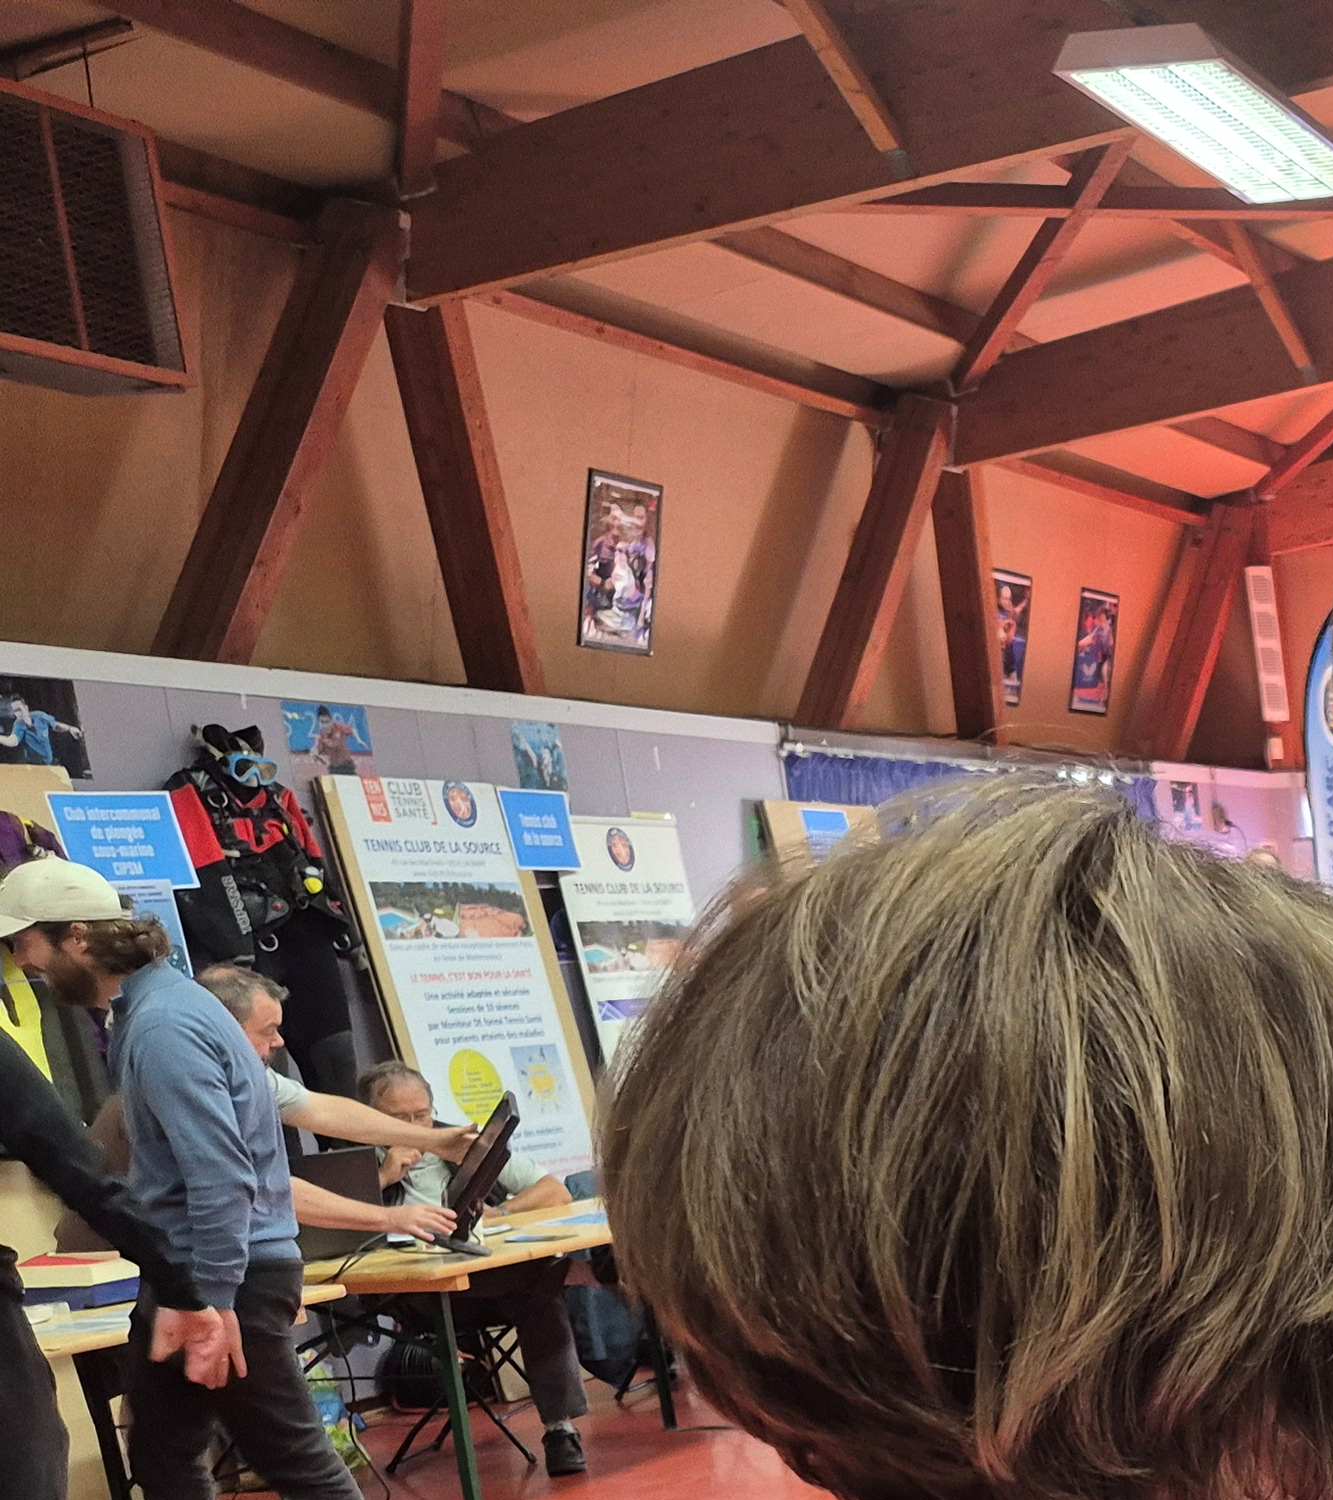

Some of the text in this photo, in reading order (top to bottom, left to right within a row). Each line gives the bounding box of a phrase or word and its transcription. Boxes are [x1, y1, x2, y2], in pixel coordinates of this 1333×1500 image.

[387, 781, 422, 796] CLUB
[363, 838, 503, 855] TENNIS CLUB DE LA SOURCE
